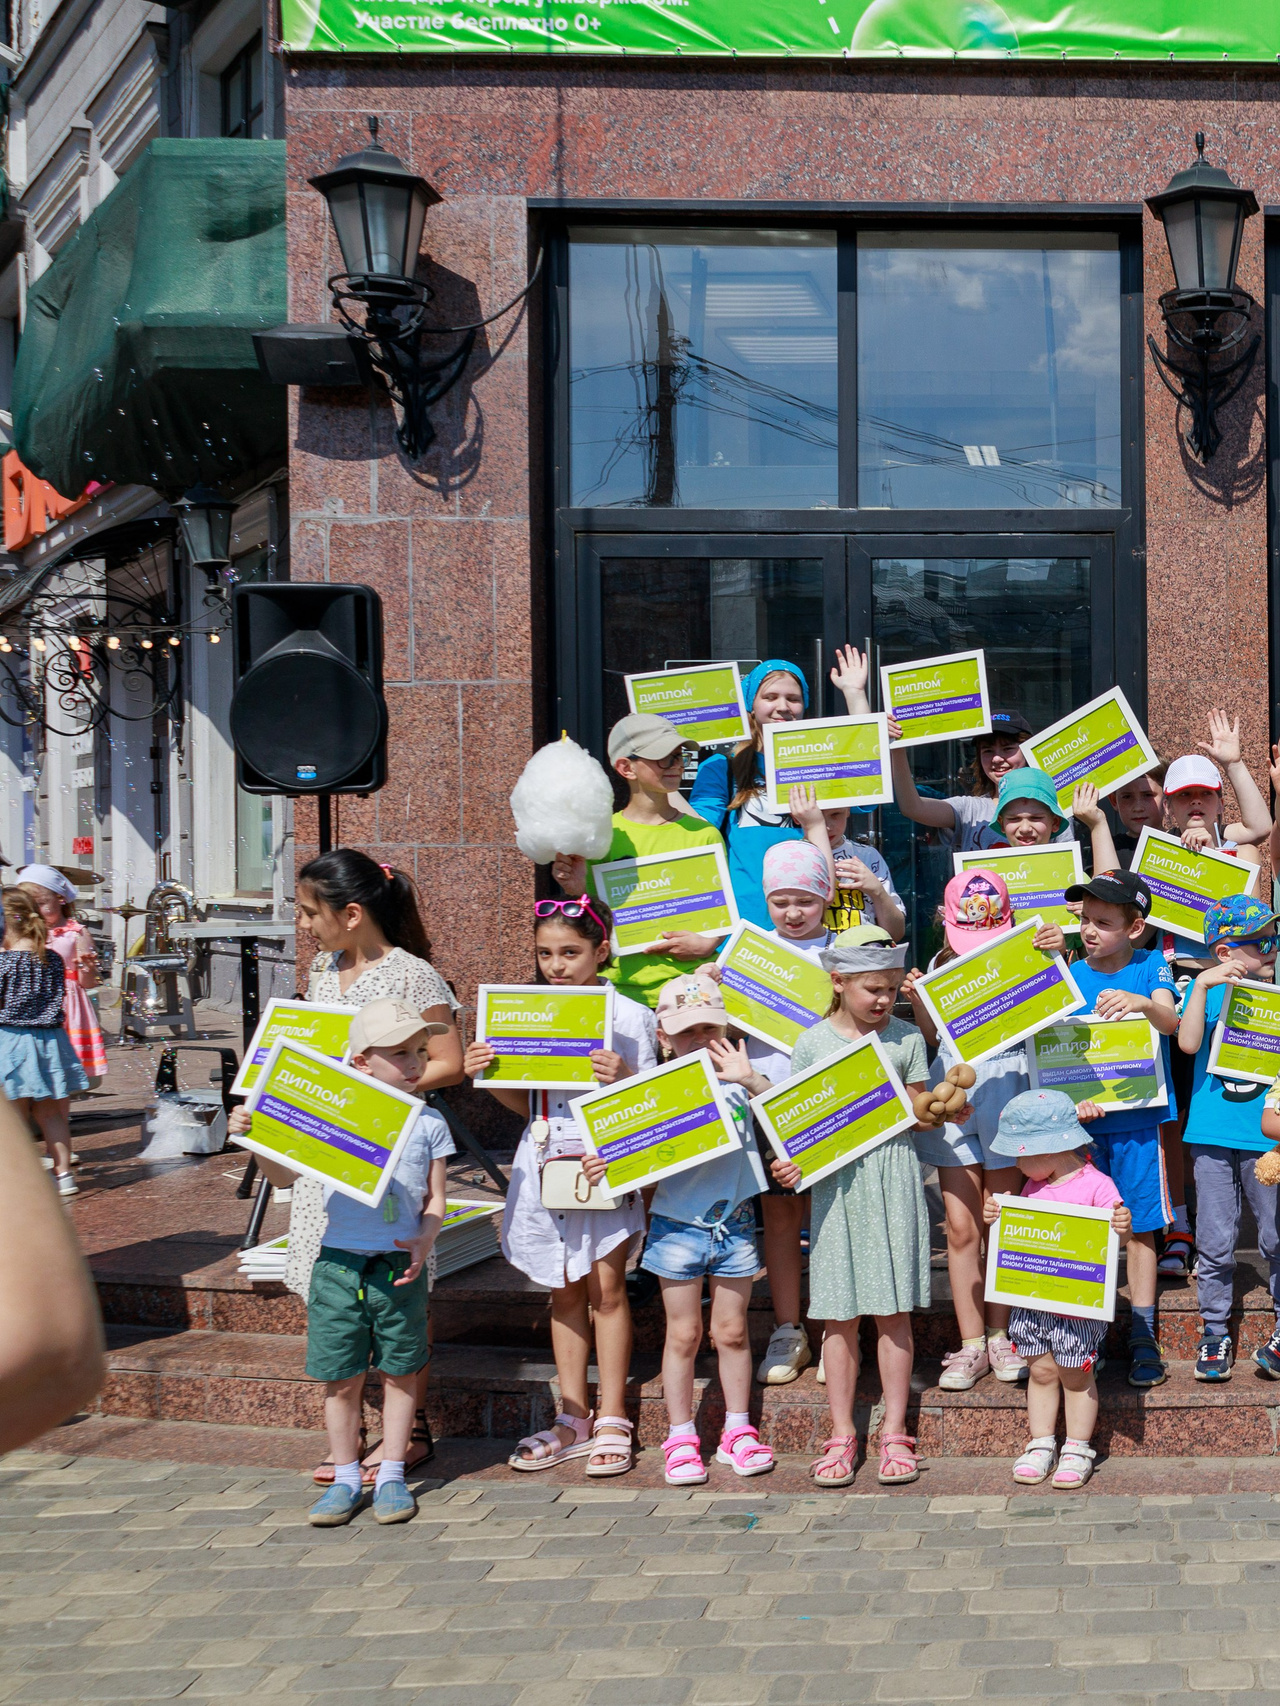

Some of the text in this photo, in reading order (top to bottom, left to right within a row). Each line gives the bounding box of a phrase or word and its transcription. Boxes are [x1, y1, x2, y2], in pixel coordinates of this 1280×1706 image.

[355, 11, 601, 32] Участие бесплатно 0+
[894, 679, 941, 696] ДИПЛОМ
[1041, 734, 1089, 768] ДИПЛОМ
[1069, 759, 1090, 774] САМОМУ
[1089, 738, 1125, 762] ТАЛАНТЛИВОМУ
[1073, 759, 1101, 779] КОНДИТЕРУ
[1146, 853, 1201, 880] ДИПЛОМ
[1140, 876, 1160, 887] ВЫДАН
[1160, 884, 1184, 896] САМОМУ
[1160, 890, 1192, 906] КОНДИТЕРУ
[938, 968, 1001, 1009] ДИПЛОМ
[951, 973, 1048, 1030] ВЫДАН САМОМУ ТАЛАНТЛИВОМУ
[954, 999, 1015, 1036] ЮНОМУ КОНДИТЕРУ
[1039, 1039, 1101, 1056] ДИПЛОМ
[1227, 1036, 1251, 1046] ЮНОМУ
[1228, 1030, 1278, 1044] ВЫДАН САМОМУ
[592, 1097, 658, 1133] ДИПЛОМ
[774, 1085, 836, 1128] ДИПЛОМ
[787, 1090, 882, 1148] ВЫДАН САМОМУ ТАЛАНТЛИВОМУ
[601, 1109, 706, 1155] ВЫДАН САМОМУ ТАЛАНТЛИВОМУ
[790, 1116, 850, 1154] ЮНОМУ КОНДИТЕРУ
[604, 1131, 669, 1161] ЮНОМУ КОНДИТЕРУ
[1004, 1224, 1060, 1244] ДИПЛОМ
[1001, 1260, 1058, 1274] ЮНОМУ КОНДИТЕРУ
[1002, 1253, 1094, 1272] ВЫДАН САМОМУ ТАЛАНТЛИВОМУ
